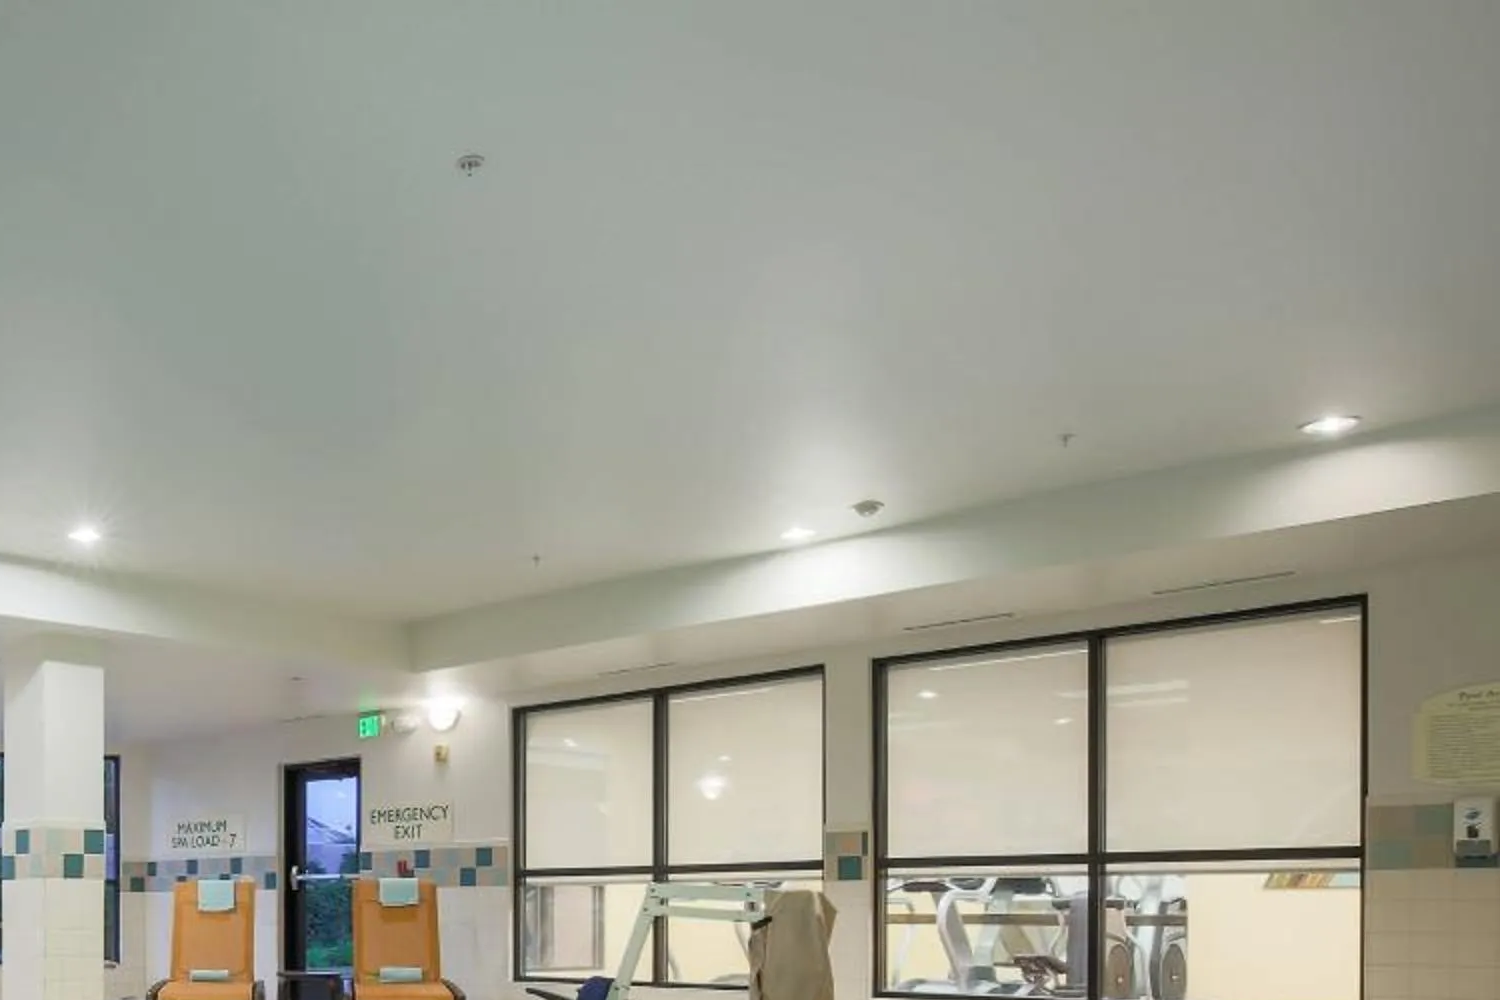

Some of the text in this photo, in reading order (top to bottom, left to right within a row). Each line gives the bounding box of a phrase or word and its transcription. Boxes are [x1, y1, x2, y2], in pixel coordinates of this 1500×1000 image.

[370, 804, 449, 825] EMERGENCY
[177, 819, 227, 834] MAXIMUM
[394, 823, 422, 839] EXIT
[191, 834, 221, 849] LOAD
